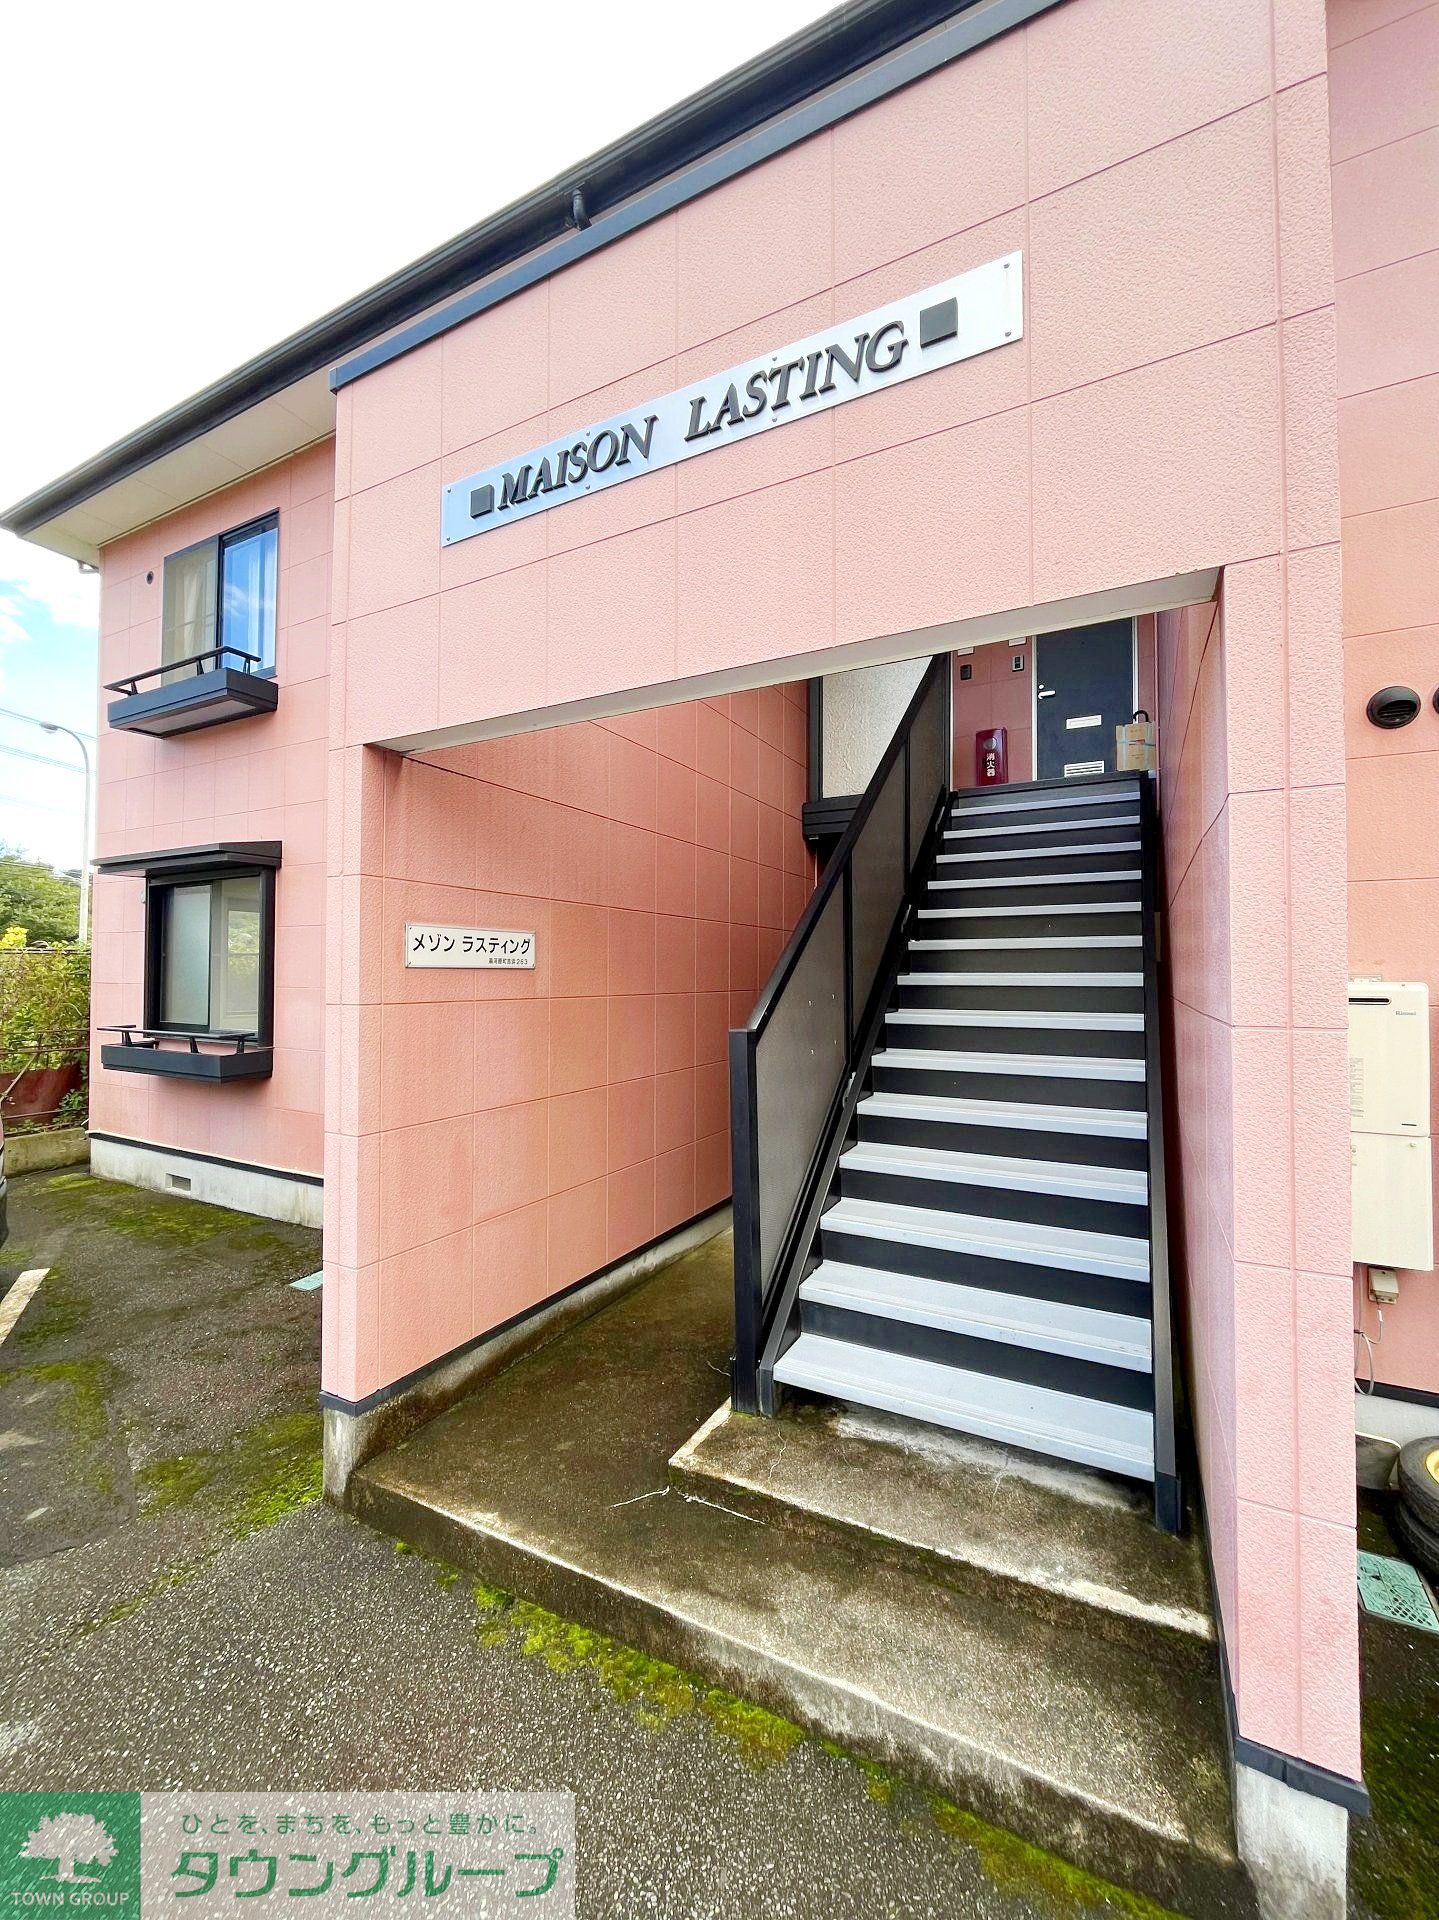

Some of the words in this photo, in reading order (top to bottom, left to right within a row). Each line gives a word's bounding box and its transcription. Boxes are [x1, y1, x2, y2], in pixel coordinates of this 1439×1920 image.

[497, 414, 659, 511] MAISON
[684, 320, 909, 442] LASTING
[986, 752, 996, 777] 消火器
[413, 933, 455, 952] メゾン
[462, 936, 531, 955] ラスティング
